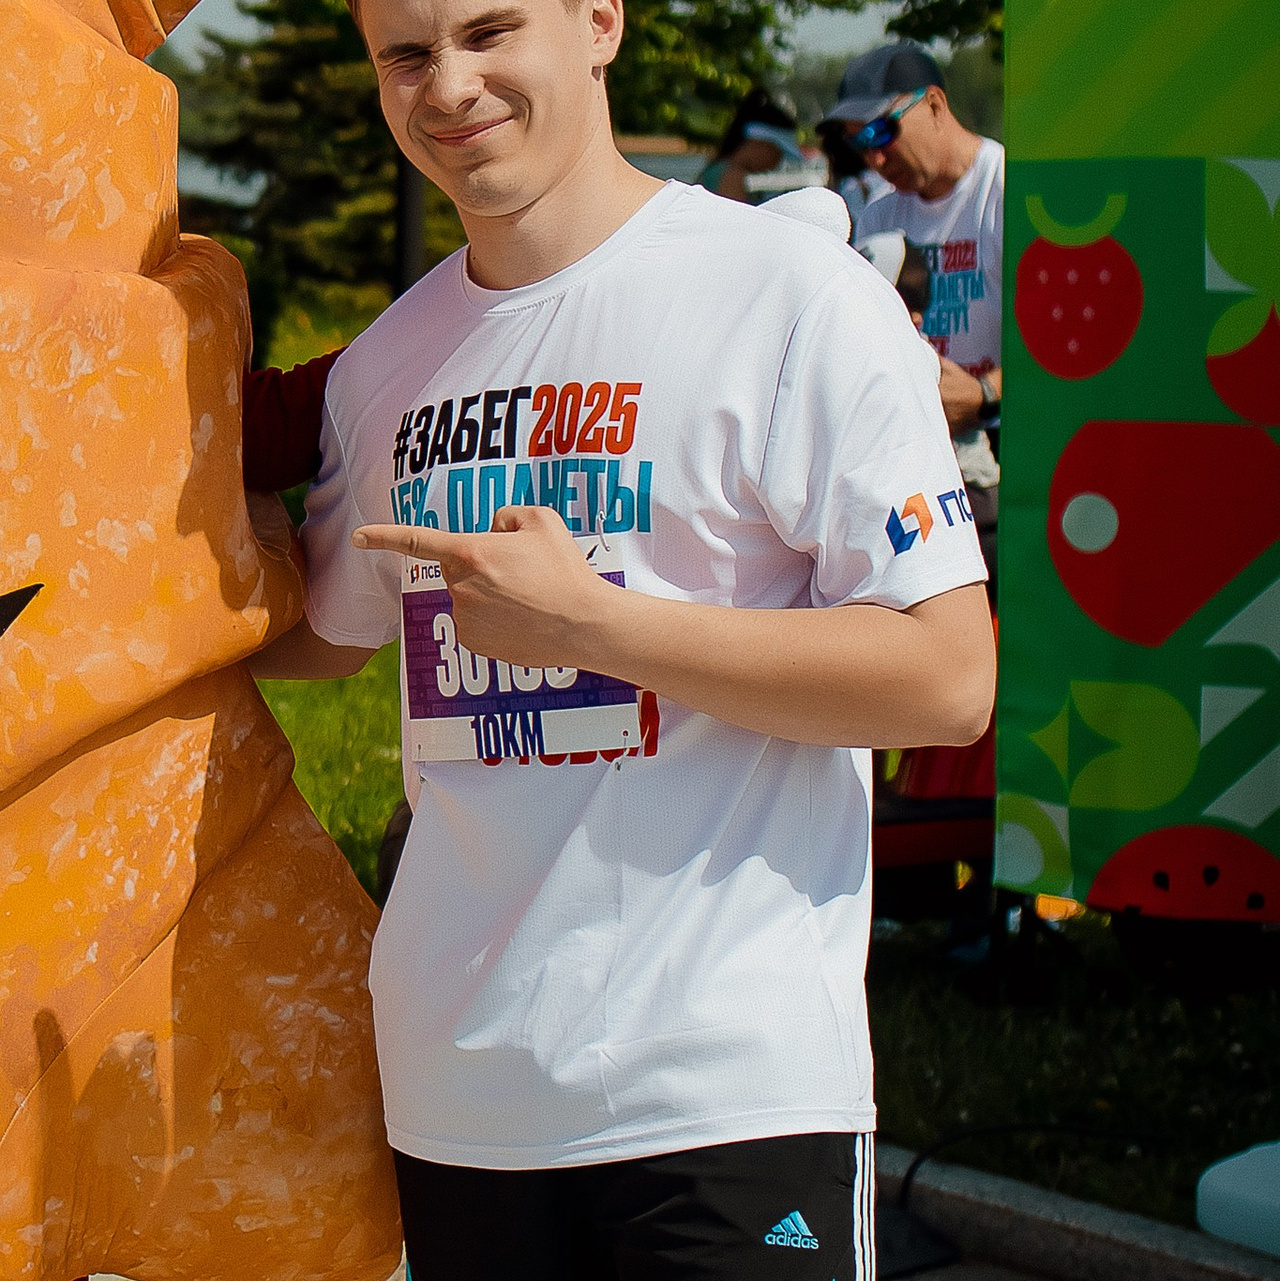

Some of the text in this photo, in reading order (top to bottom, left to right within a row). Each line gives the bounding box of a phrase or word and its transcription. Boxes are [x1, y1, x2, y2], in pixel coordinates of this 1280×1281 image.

[421, 564, 442, 580] ПСБ
[471, 709, 546, 760] 10КМ
[764, 1231, 820, 1250] adidas
